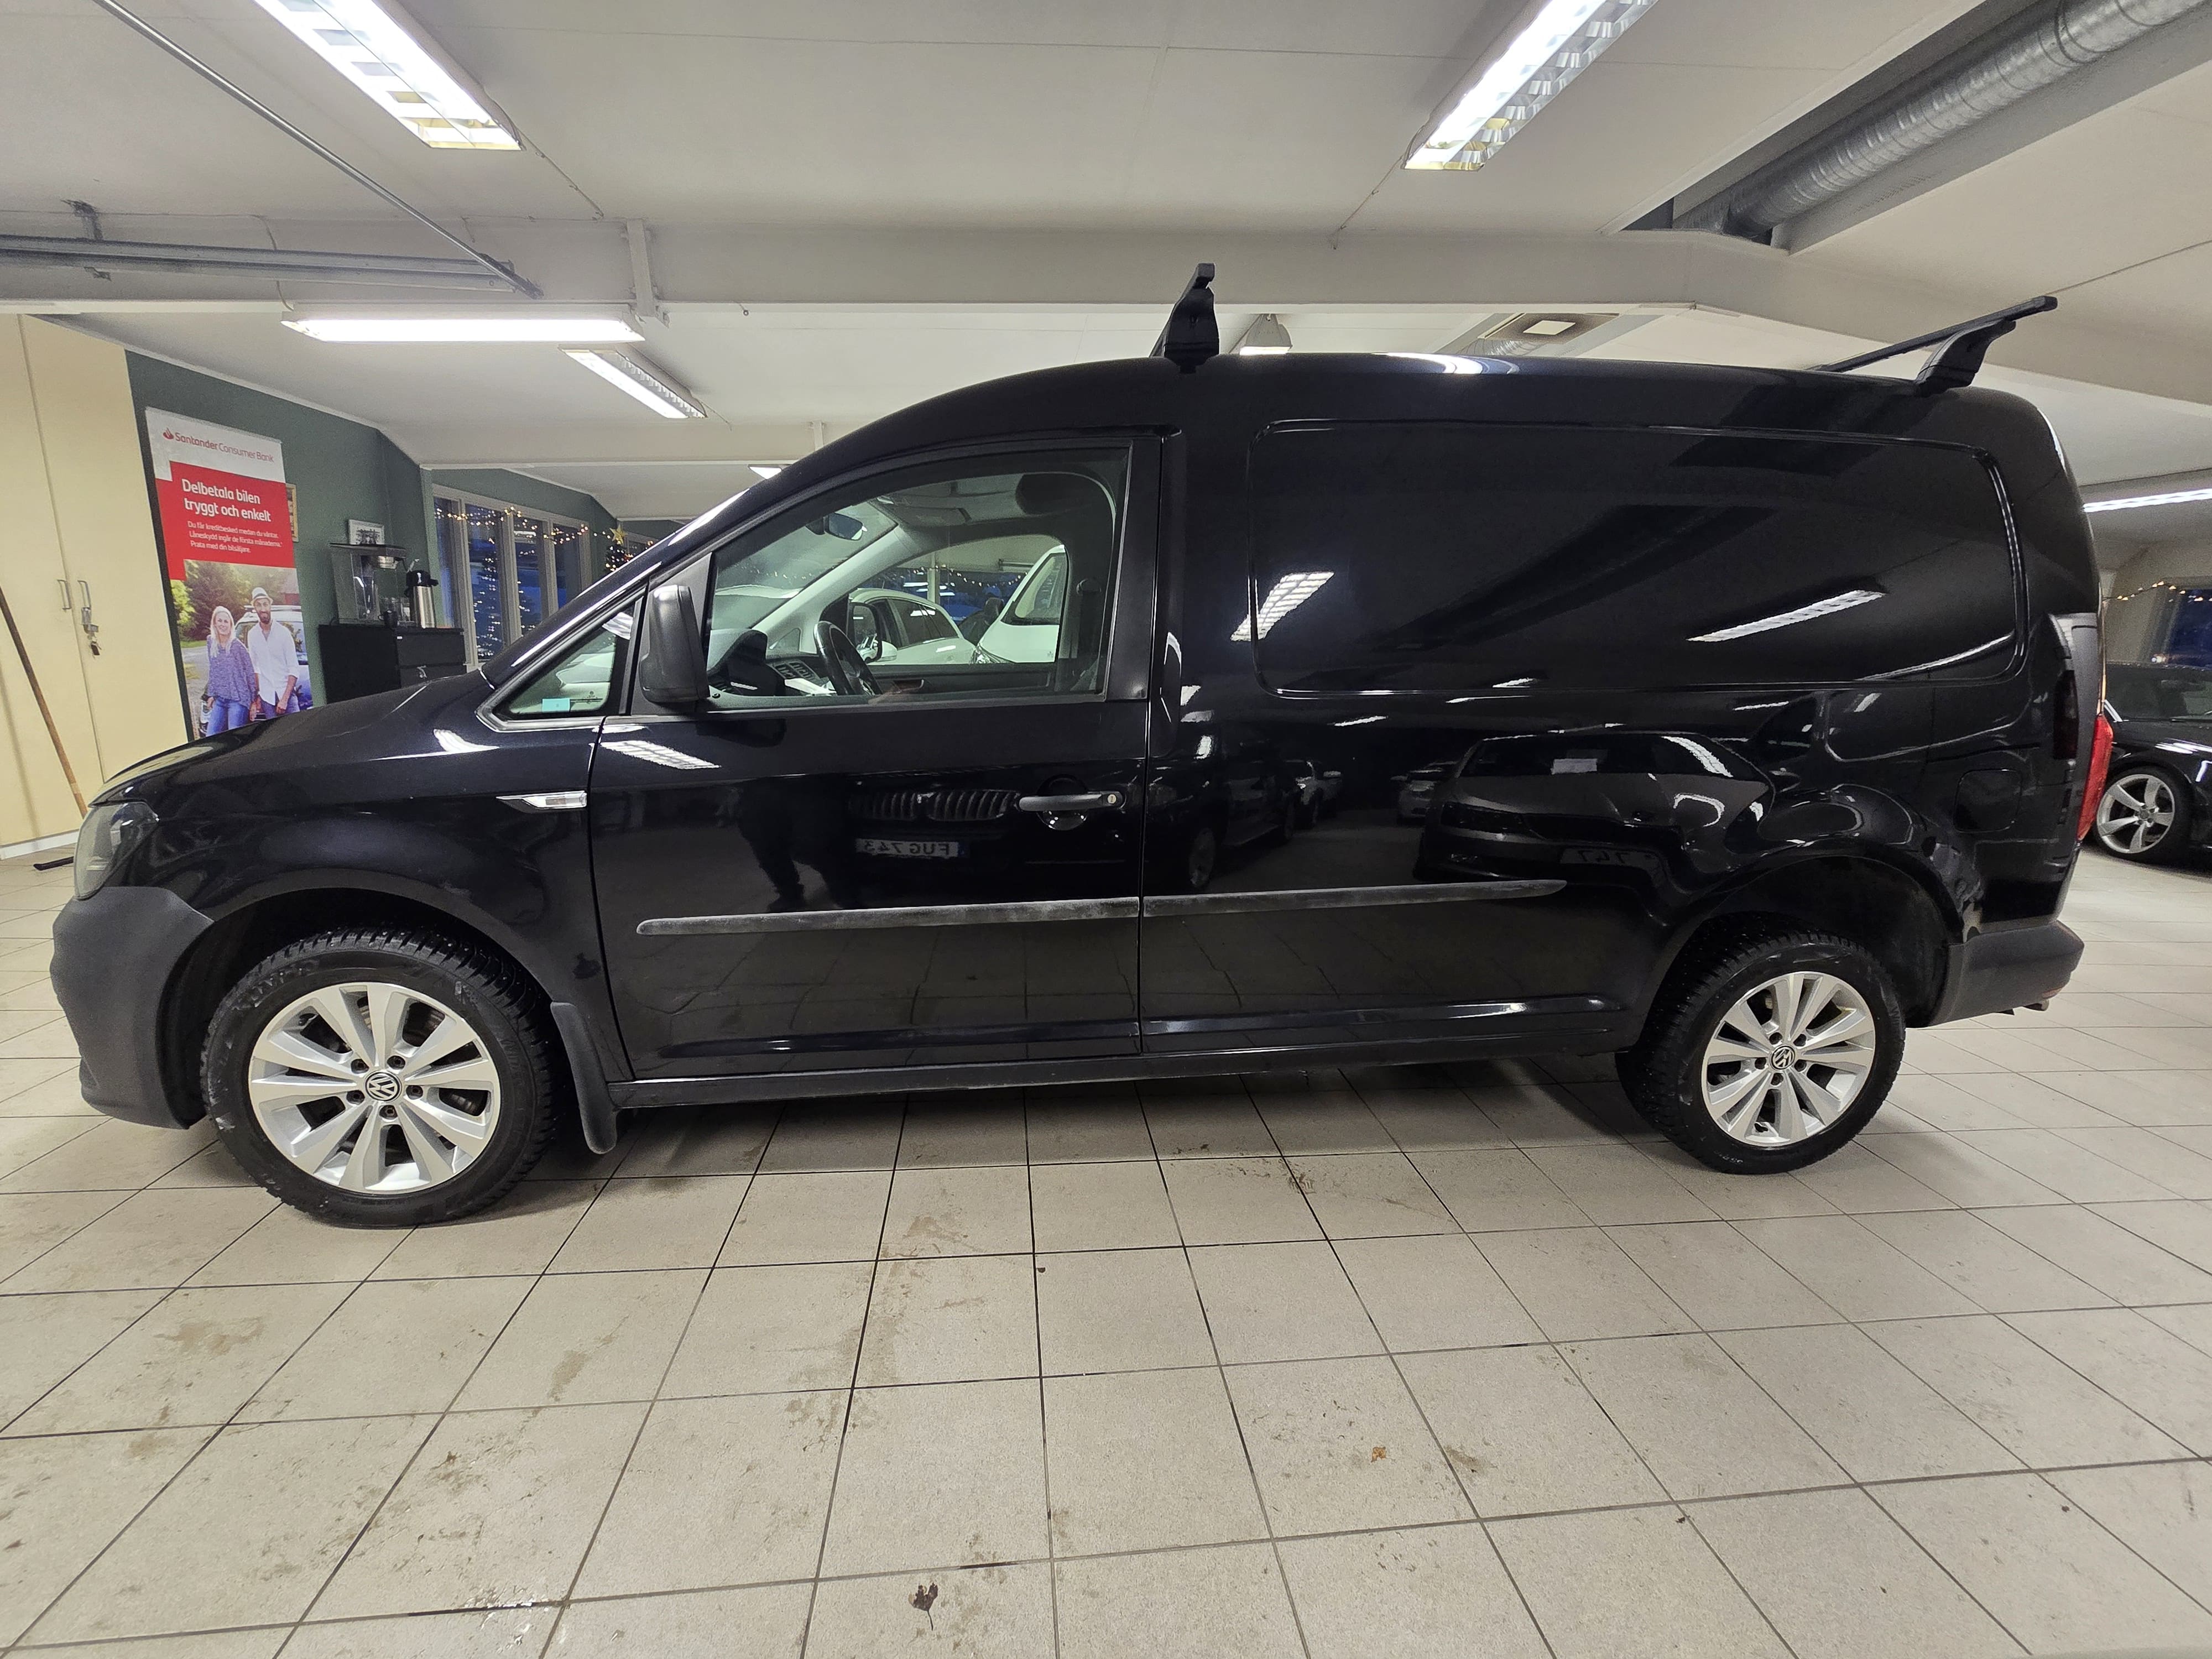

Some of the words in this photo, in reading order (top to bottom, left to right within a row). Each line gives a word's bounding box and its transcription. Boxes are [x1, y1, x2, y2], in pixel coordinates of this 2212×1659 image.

[175, 432, 217, 451] Santander
[218, 443, 256, 459] Consumer
[257, 451, 274, 463] Bank
[181, 478, 234, 500] Delbetala
[236, 488, 260, 504] bilen
[184, 498, 219, 517] tryggt
[221, 504, 239, 518] och
[241, 509, 272, 522] enkelt
[190, 540, 205, 549] Prata
